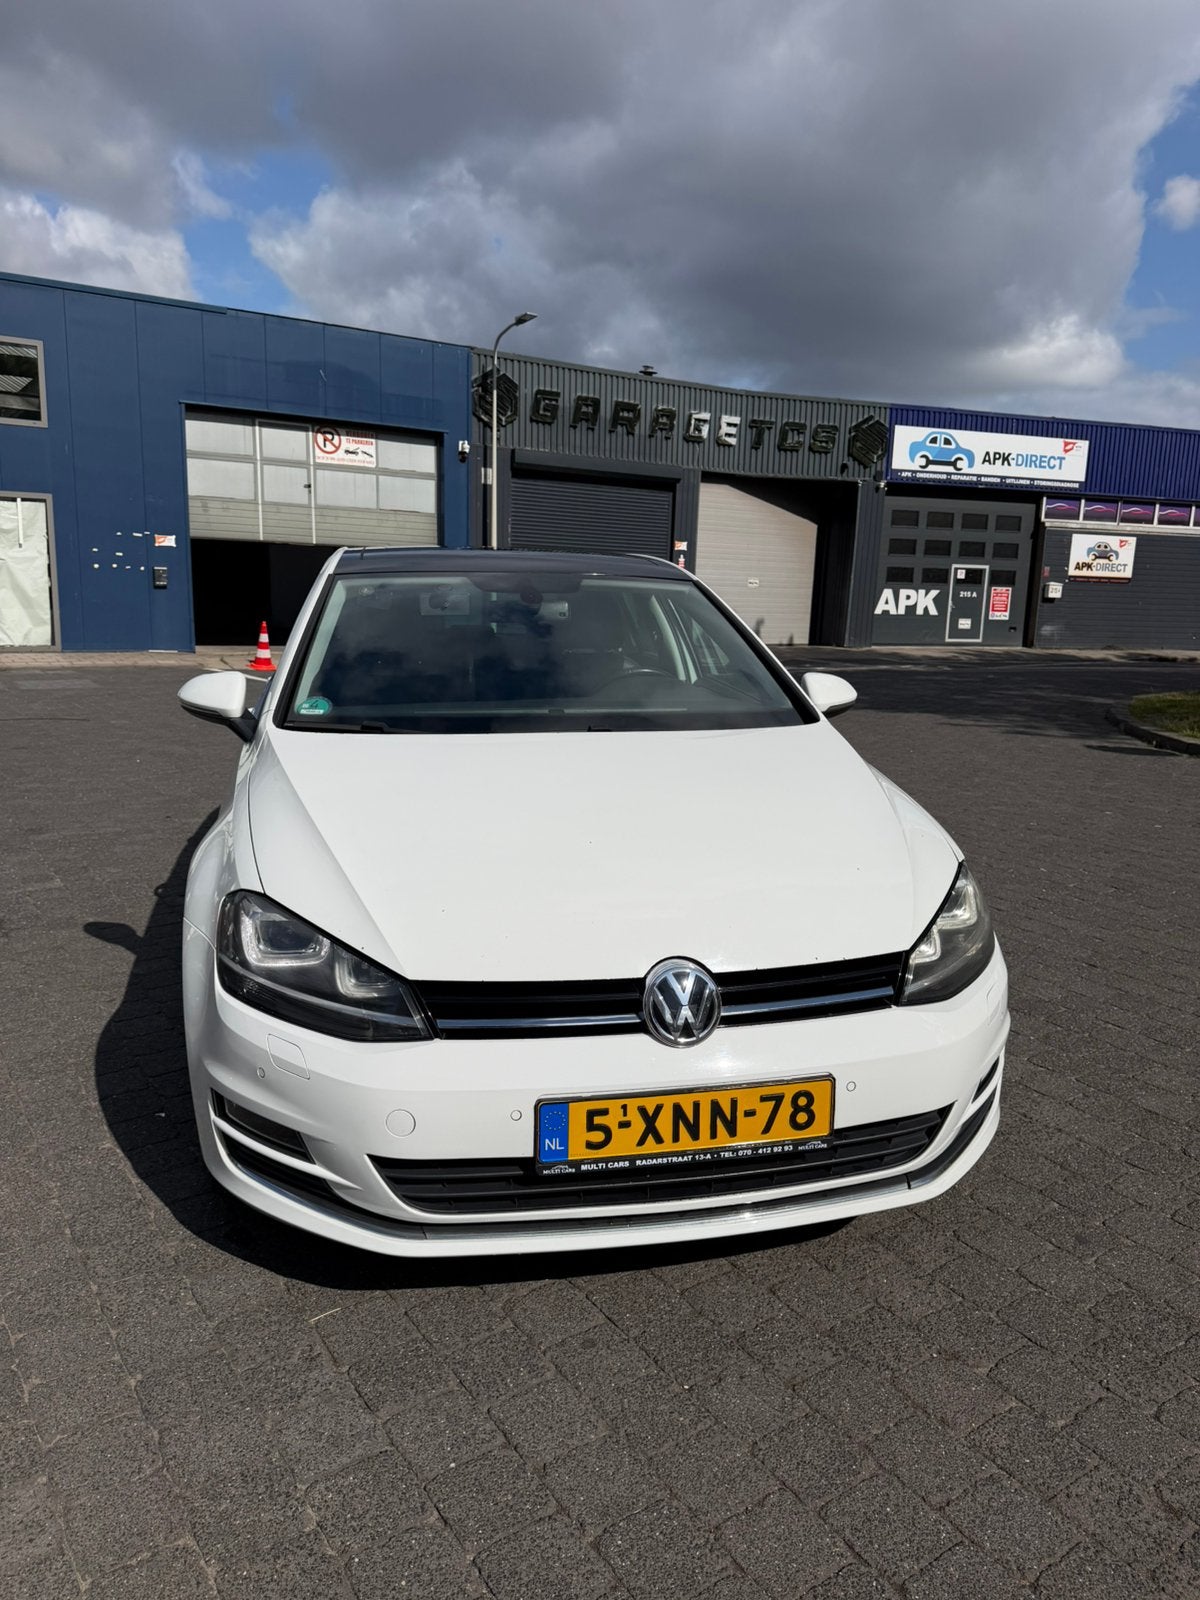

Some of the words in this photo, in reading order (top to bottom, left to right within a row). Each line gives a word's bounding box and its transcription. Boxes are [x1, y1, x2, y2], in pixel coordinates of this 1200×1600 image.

[530, 387, 741, 447] GARAGE
[748, 418, 839, 453] TCS
[981, 451, 1066, 470] APK-DIRECT
[916, 472, 947, 480] ONDERHOUD
[950, 474, 977, 482] REPARATIE
[1073, 561, 1128, 573] APK-DIRECT
[873, 588, 940, 616] APK
[545, 1138, 565, 1151] NL
[580, 1163, 606, 1171] MULTI
[636, 1155, 693, 1166] RADARSTRAAT
[695, 1152, 712, 1160] 13-A
[758, 1147, 771, 1155] 412
